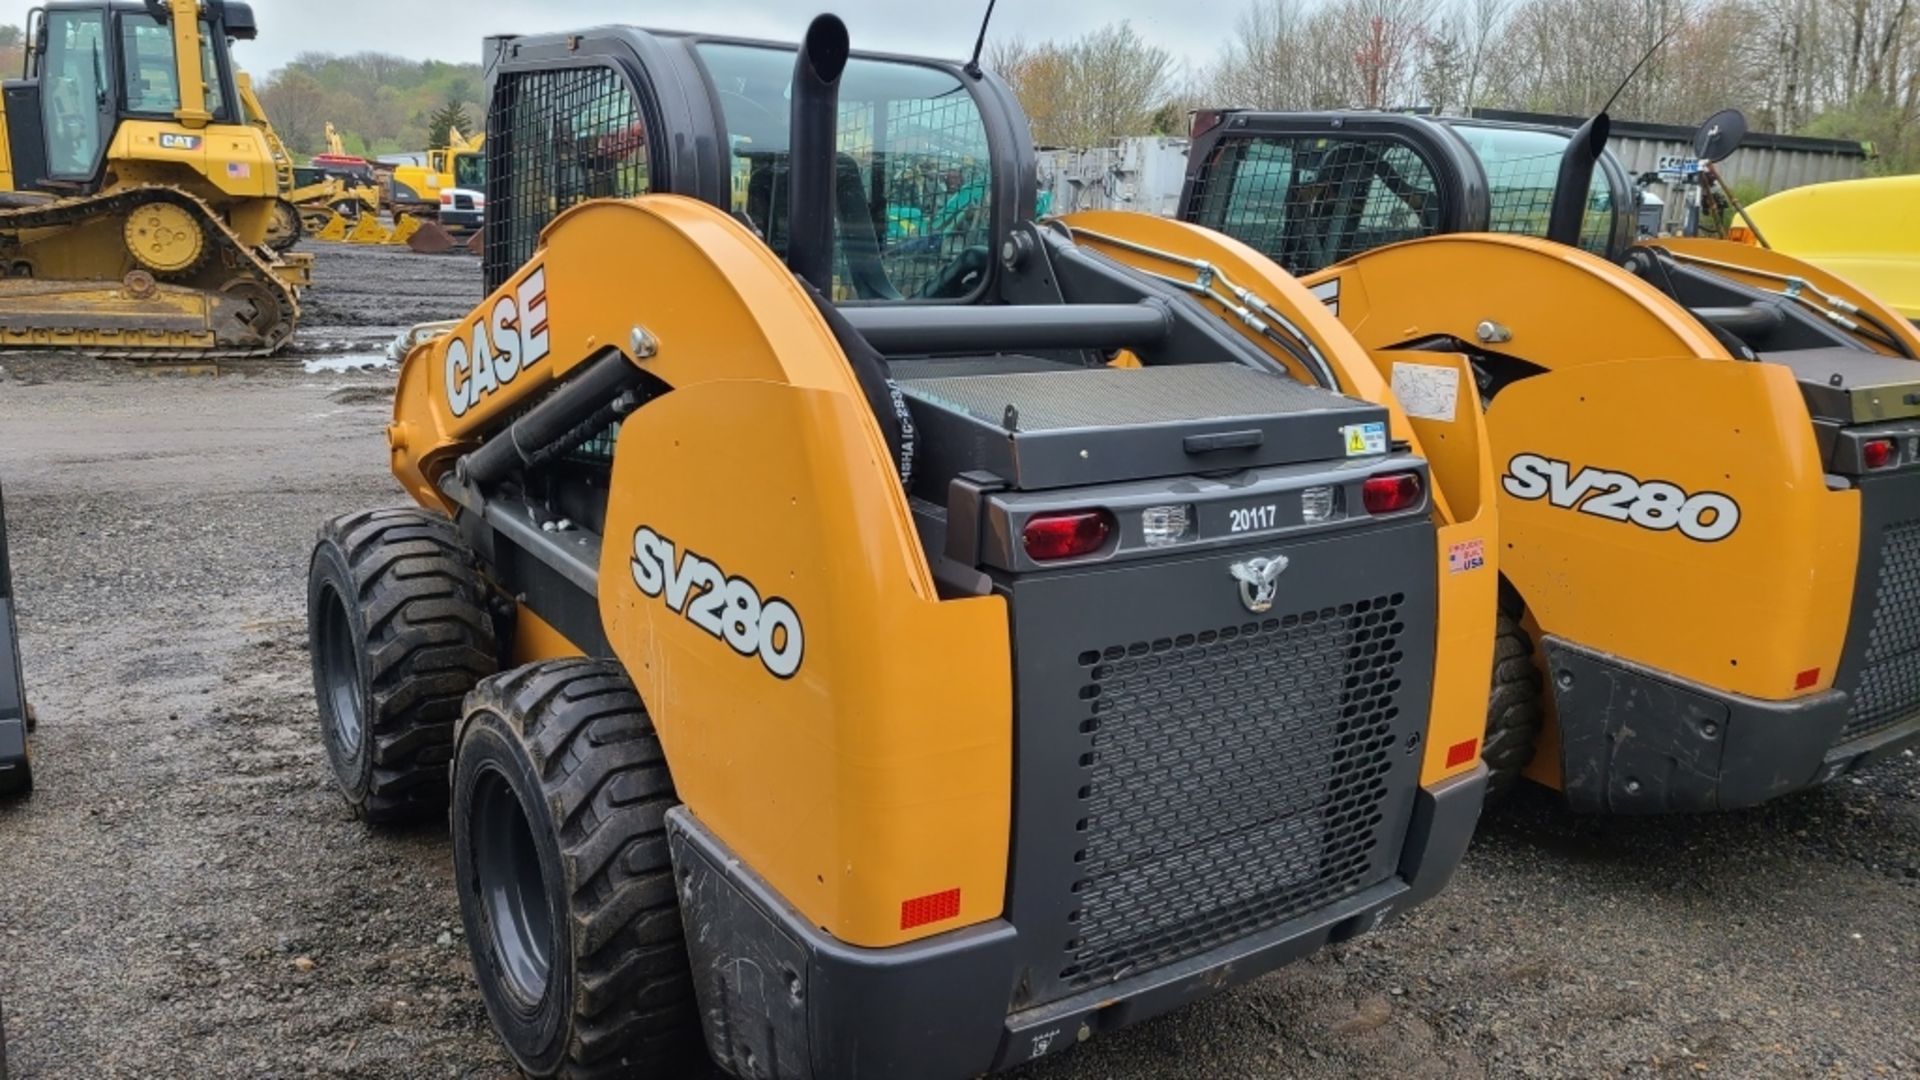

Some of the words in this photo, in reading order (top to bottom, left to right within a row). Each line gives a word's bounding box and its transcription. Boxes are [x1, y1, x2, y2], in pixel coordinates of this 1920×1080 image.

[162, 134, 194, 148] CAT
[445, 264, 550, 418] CASE
[901, 441, 914, 483] MSHA
[1229, 505, 1277, 532] 20117
[1501, 453, 1741, 542] SV280
[1464, 556, 1484, 570] USA
[630, 525, 804, 680] SV280
